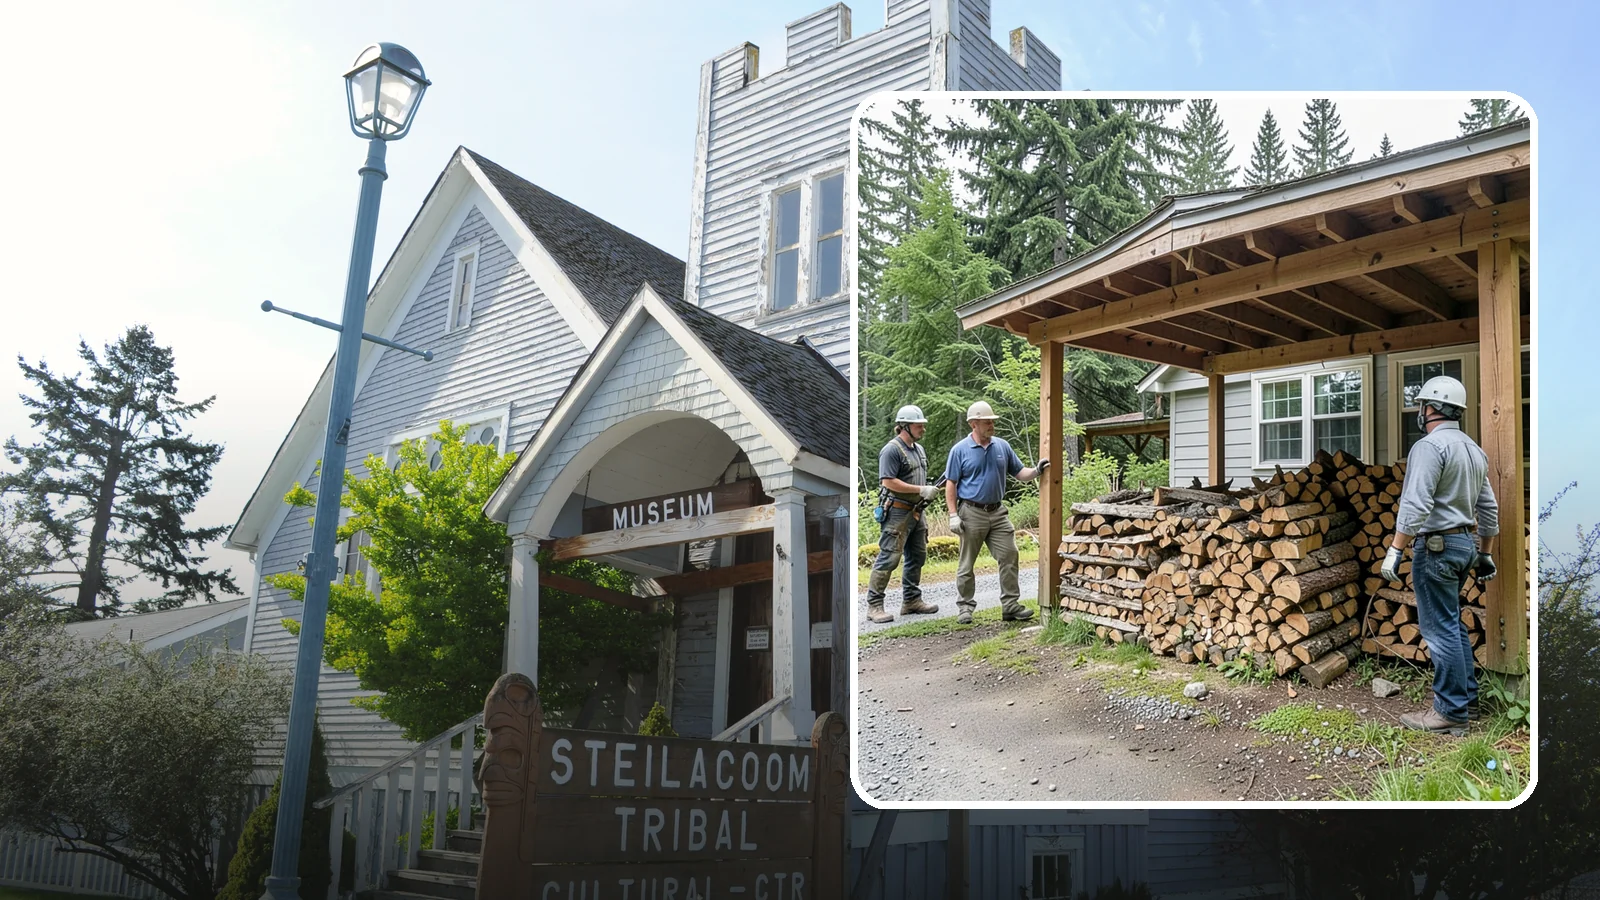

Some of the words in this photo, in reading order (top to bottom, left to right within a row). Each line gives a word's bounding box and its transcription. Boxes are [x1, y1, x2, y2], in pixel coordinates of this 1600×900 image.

[613, 491, 713, 531] MUSEUM
[551, 738, 809, 792] STEILACOOM
[615, 806, 757, 852] TRIBAL
